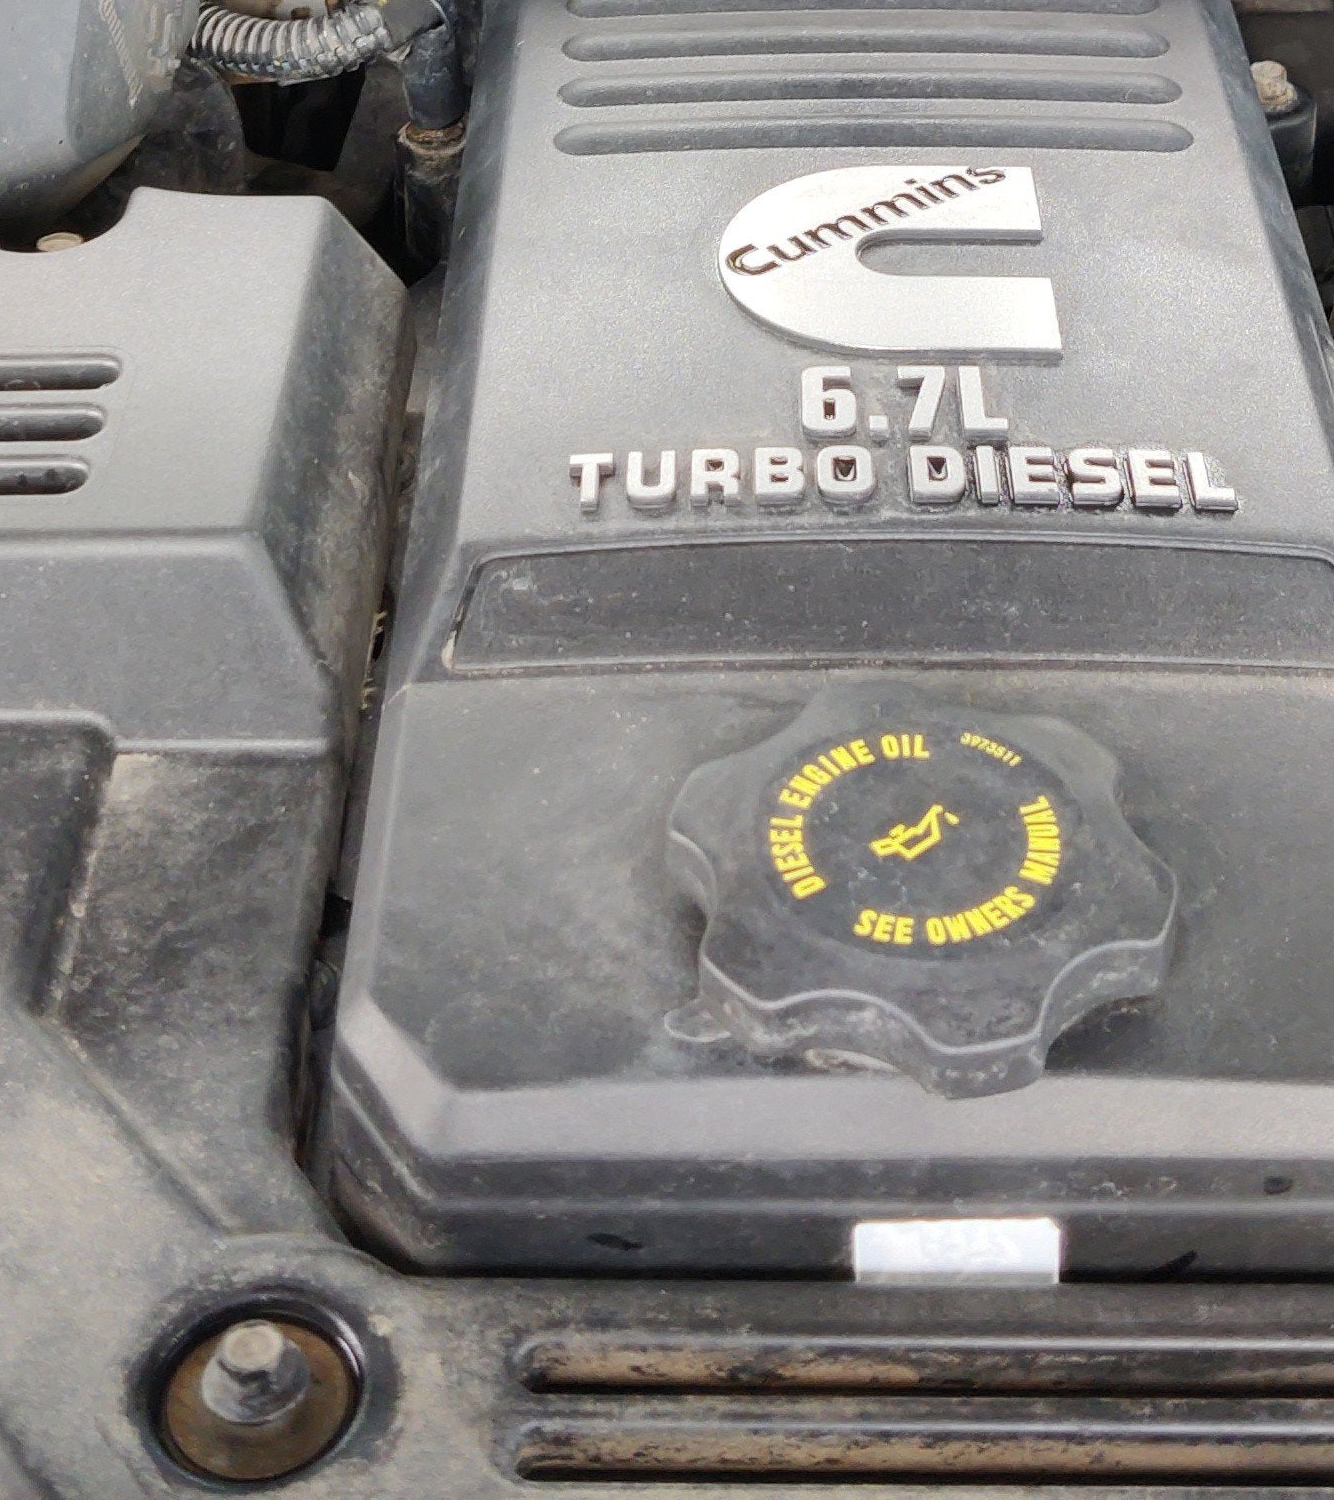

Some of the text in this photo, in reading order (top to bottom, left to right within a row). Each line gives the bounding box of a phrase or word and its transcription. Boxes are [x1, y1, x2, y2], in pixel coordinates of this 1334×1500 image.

[725, 165, 1007, 276] Cummins
[799, 364, 1009, 443] 6.7L
[569, 444, 1241, 514] TURBO DIESEL
[769, 733, 931, 899] DIESEL ENGINE OIL
[853, 794, 1061, 946] SEE OWNERS MANUAL
